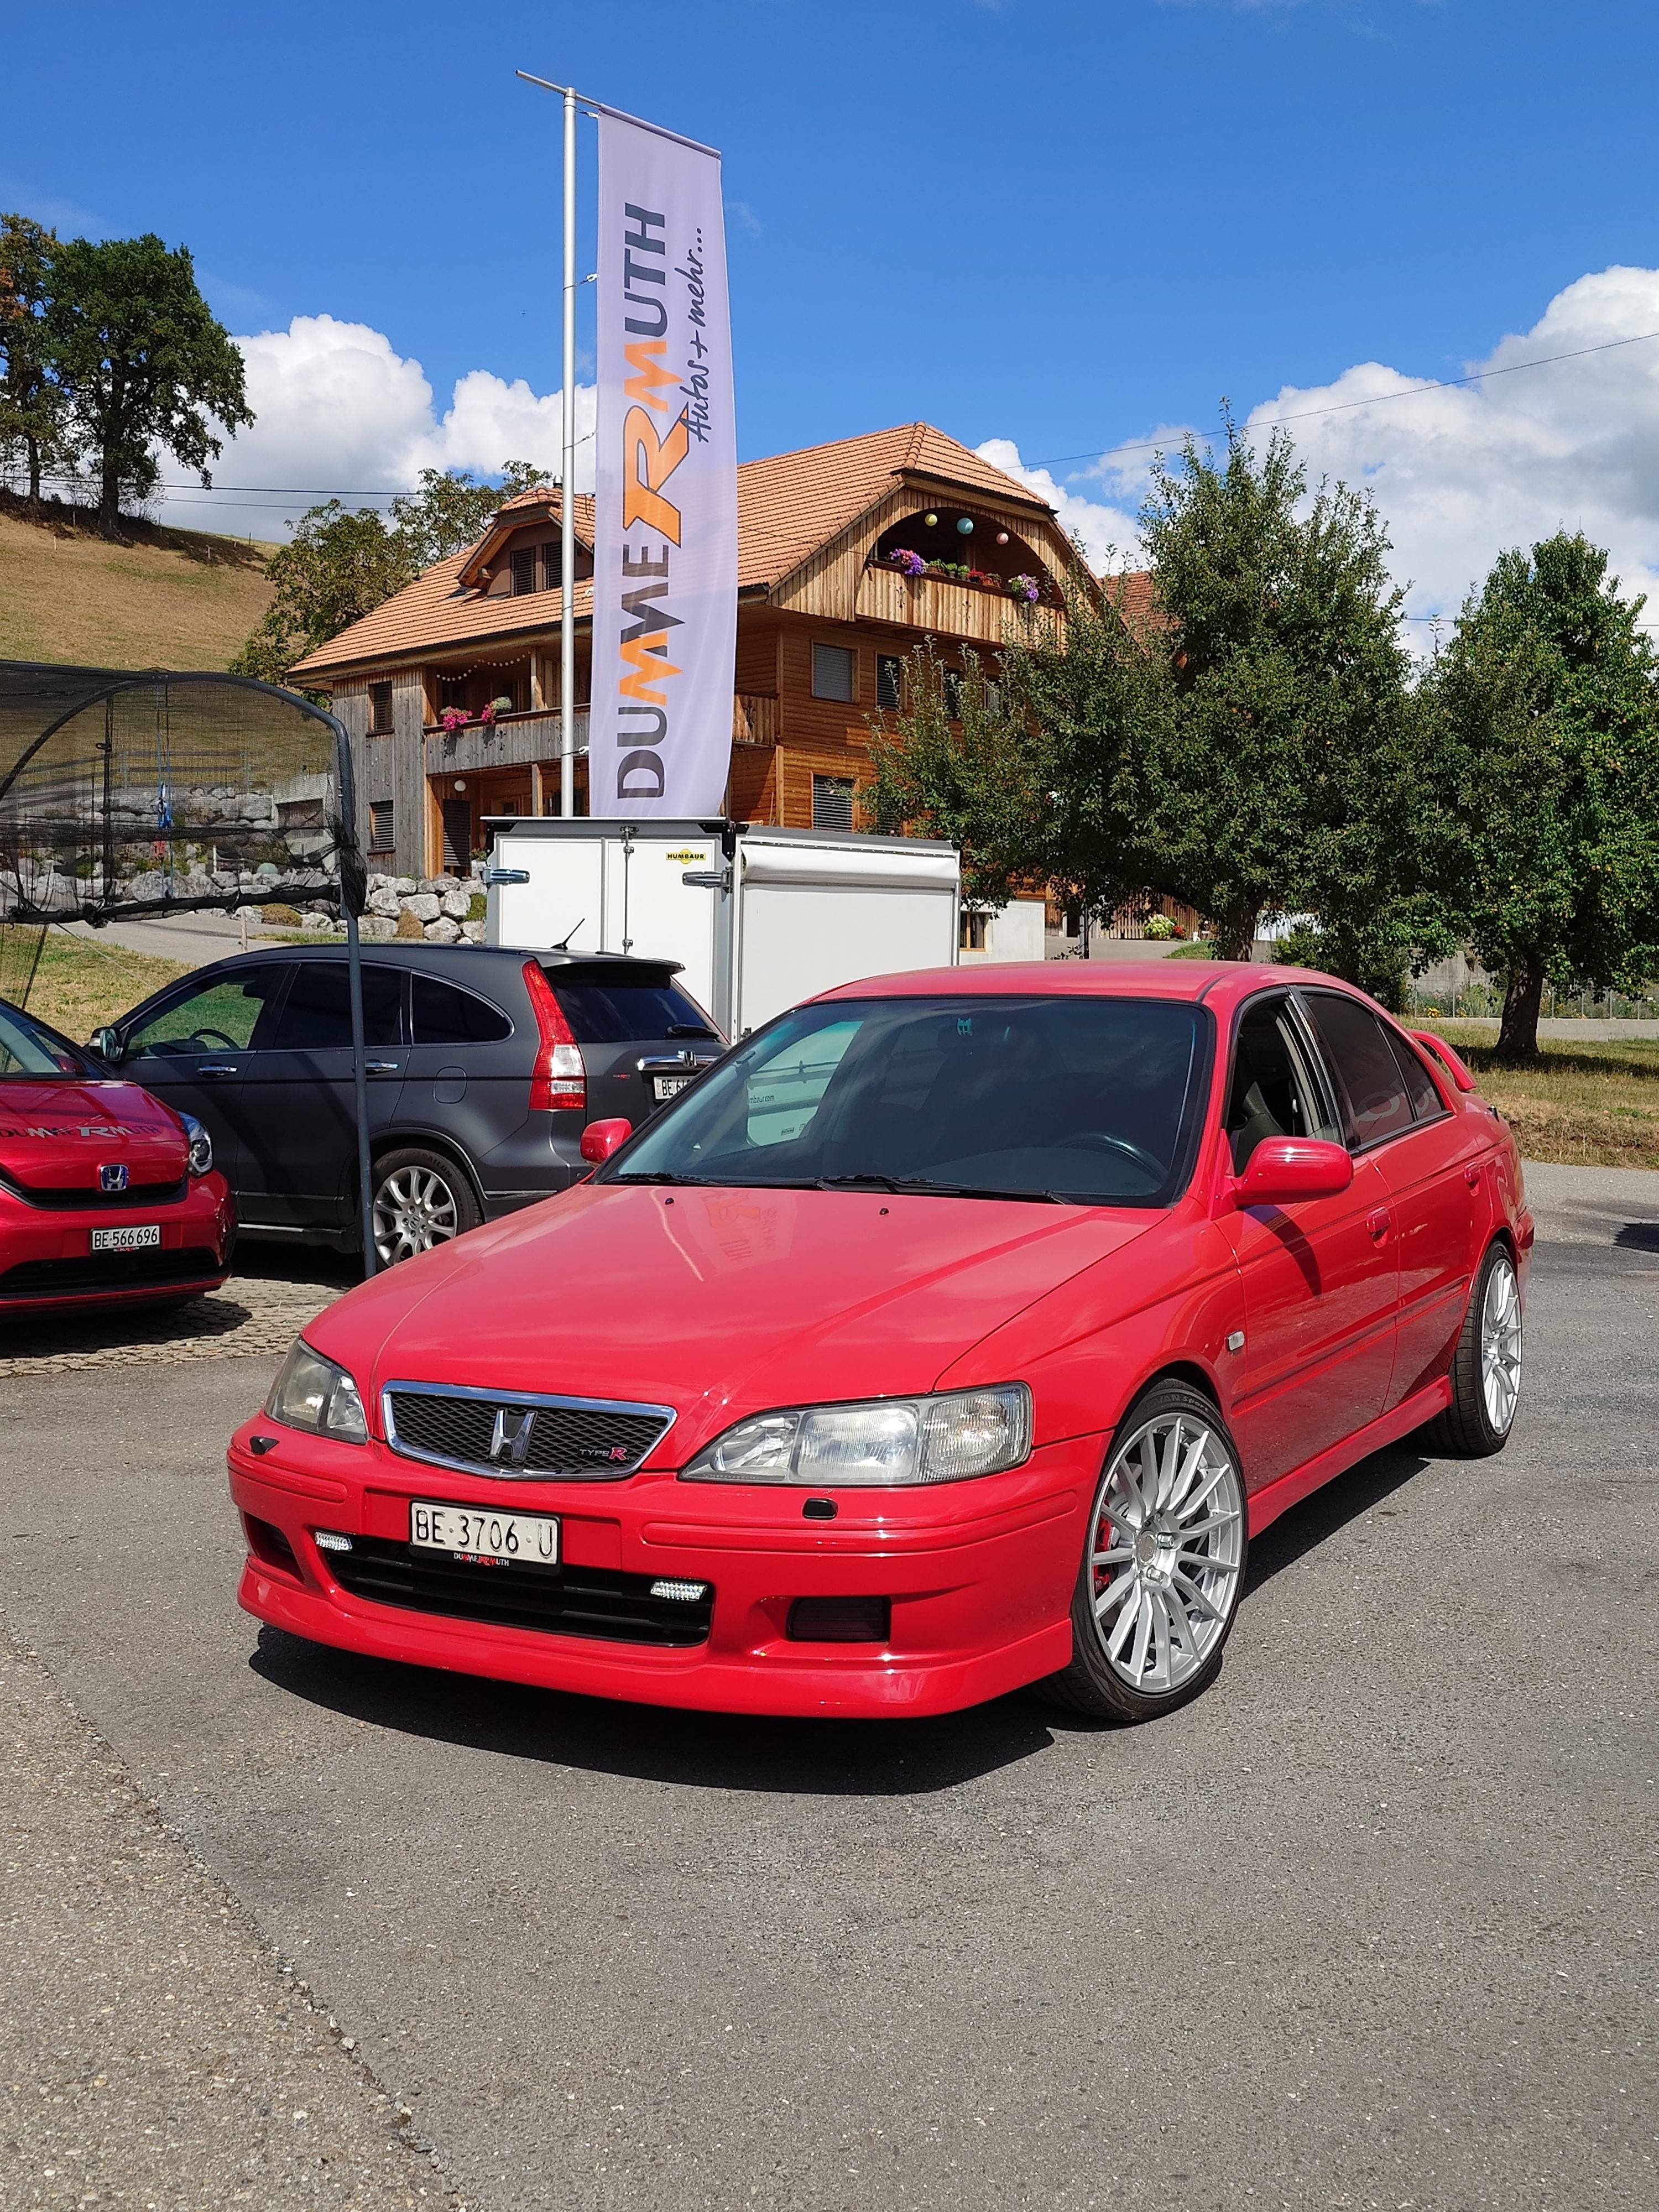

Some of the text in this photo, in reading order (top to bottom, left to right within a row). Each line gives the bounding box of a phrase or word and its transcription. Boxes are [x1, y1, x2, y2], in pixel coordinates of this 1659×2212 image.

[679, 361, 710, 444] Autos
[617, 202, 690, 799] DUMMERMUTH
[609, 1447, 628, 1461] R
